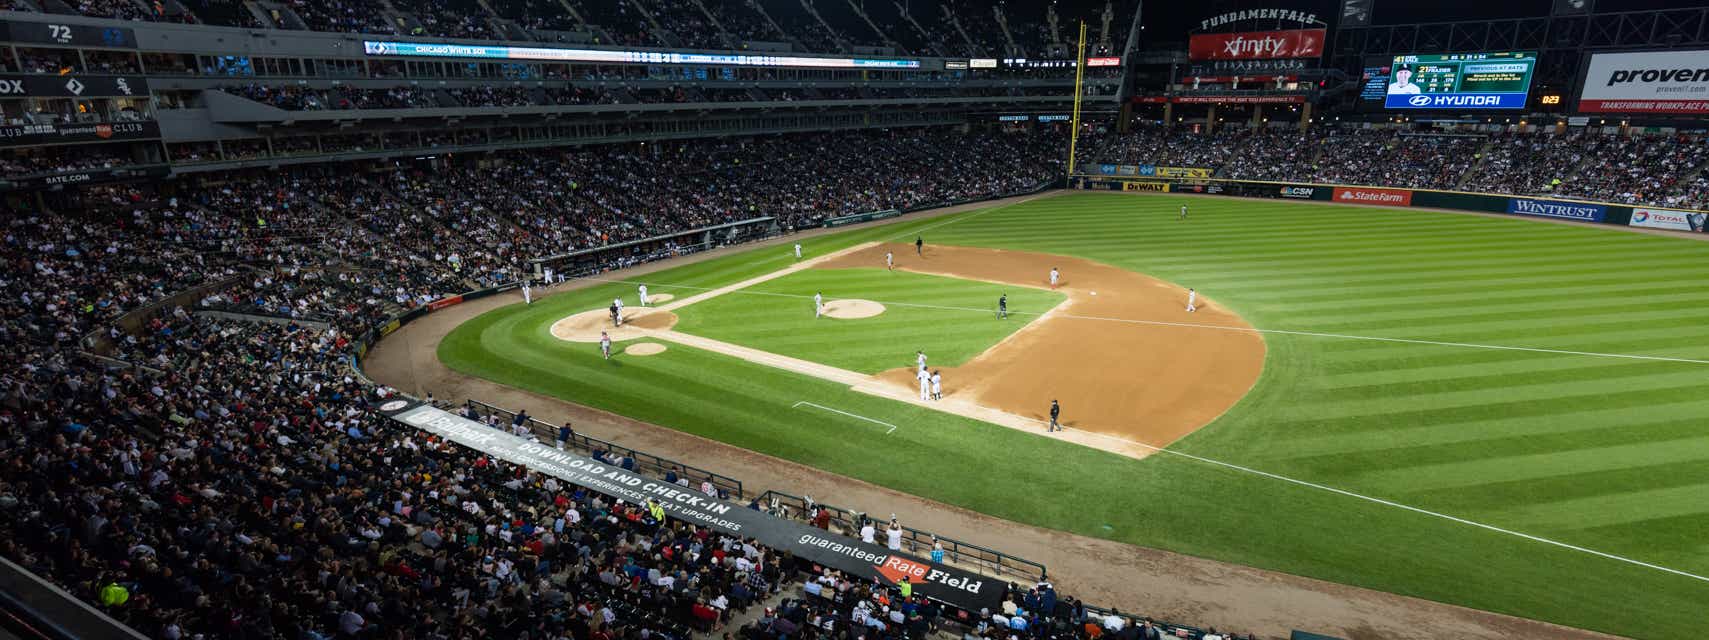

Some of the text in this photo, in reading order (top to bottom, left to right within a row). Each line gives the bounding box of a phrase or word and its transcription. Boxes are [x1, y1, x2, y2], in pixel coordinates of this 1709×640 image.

[1201, 8, 1315, 30] FUNDAMENTALS
[48, 24, 72, 39] 72
[416, 46, 448, 54] CHICAGO
[448, 46, 472, 56] WHITE
[1224, 35, 1285, 53] xfinity
[1607, 68, 1709, 86] proven
[1434, 95, 1500, 105] HYUNDAI
[113, 124, 143, 132] CLUB
[46, 174, 90, 184] RATE.COM
[1293, 187, 1314, 195] CSN
[1653, 214, 1685, 222] TOTAL
[517, 443, 731, 514] DOWNLOAD AND CHECK-IN
[580, 476, 644, 500] EXPERIENCES
[682, 508, 742, 531] UPGRADES
[798, 531, 982, 595] guaranteed Rate Field
